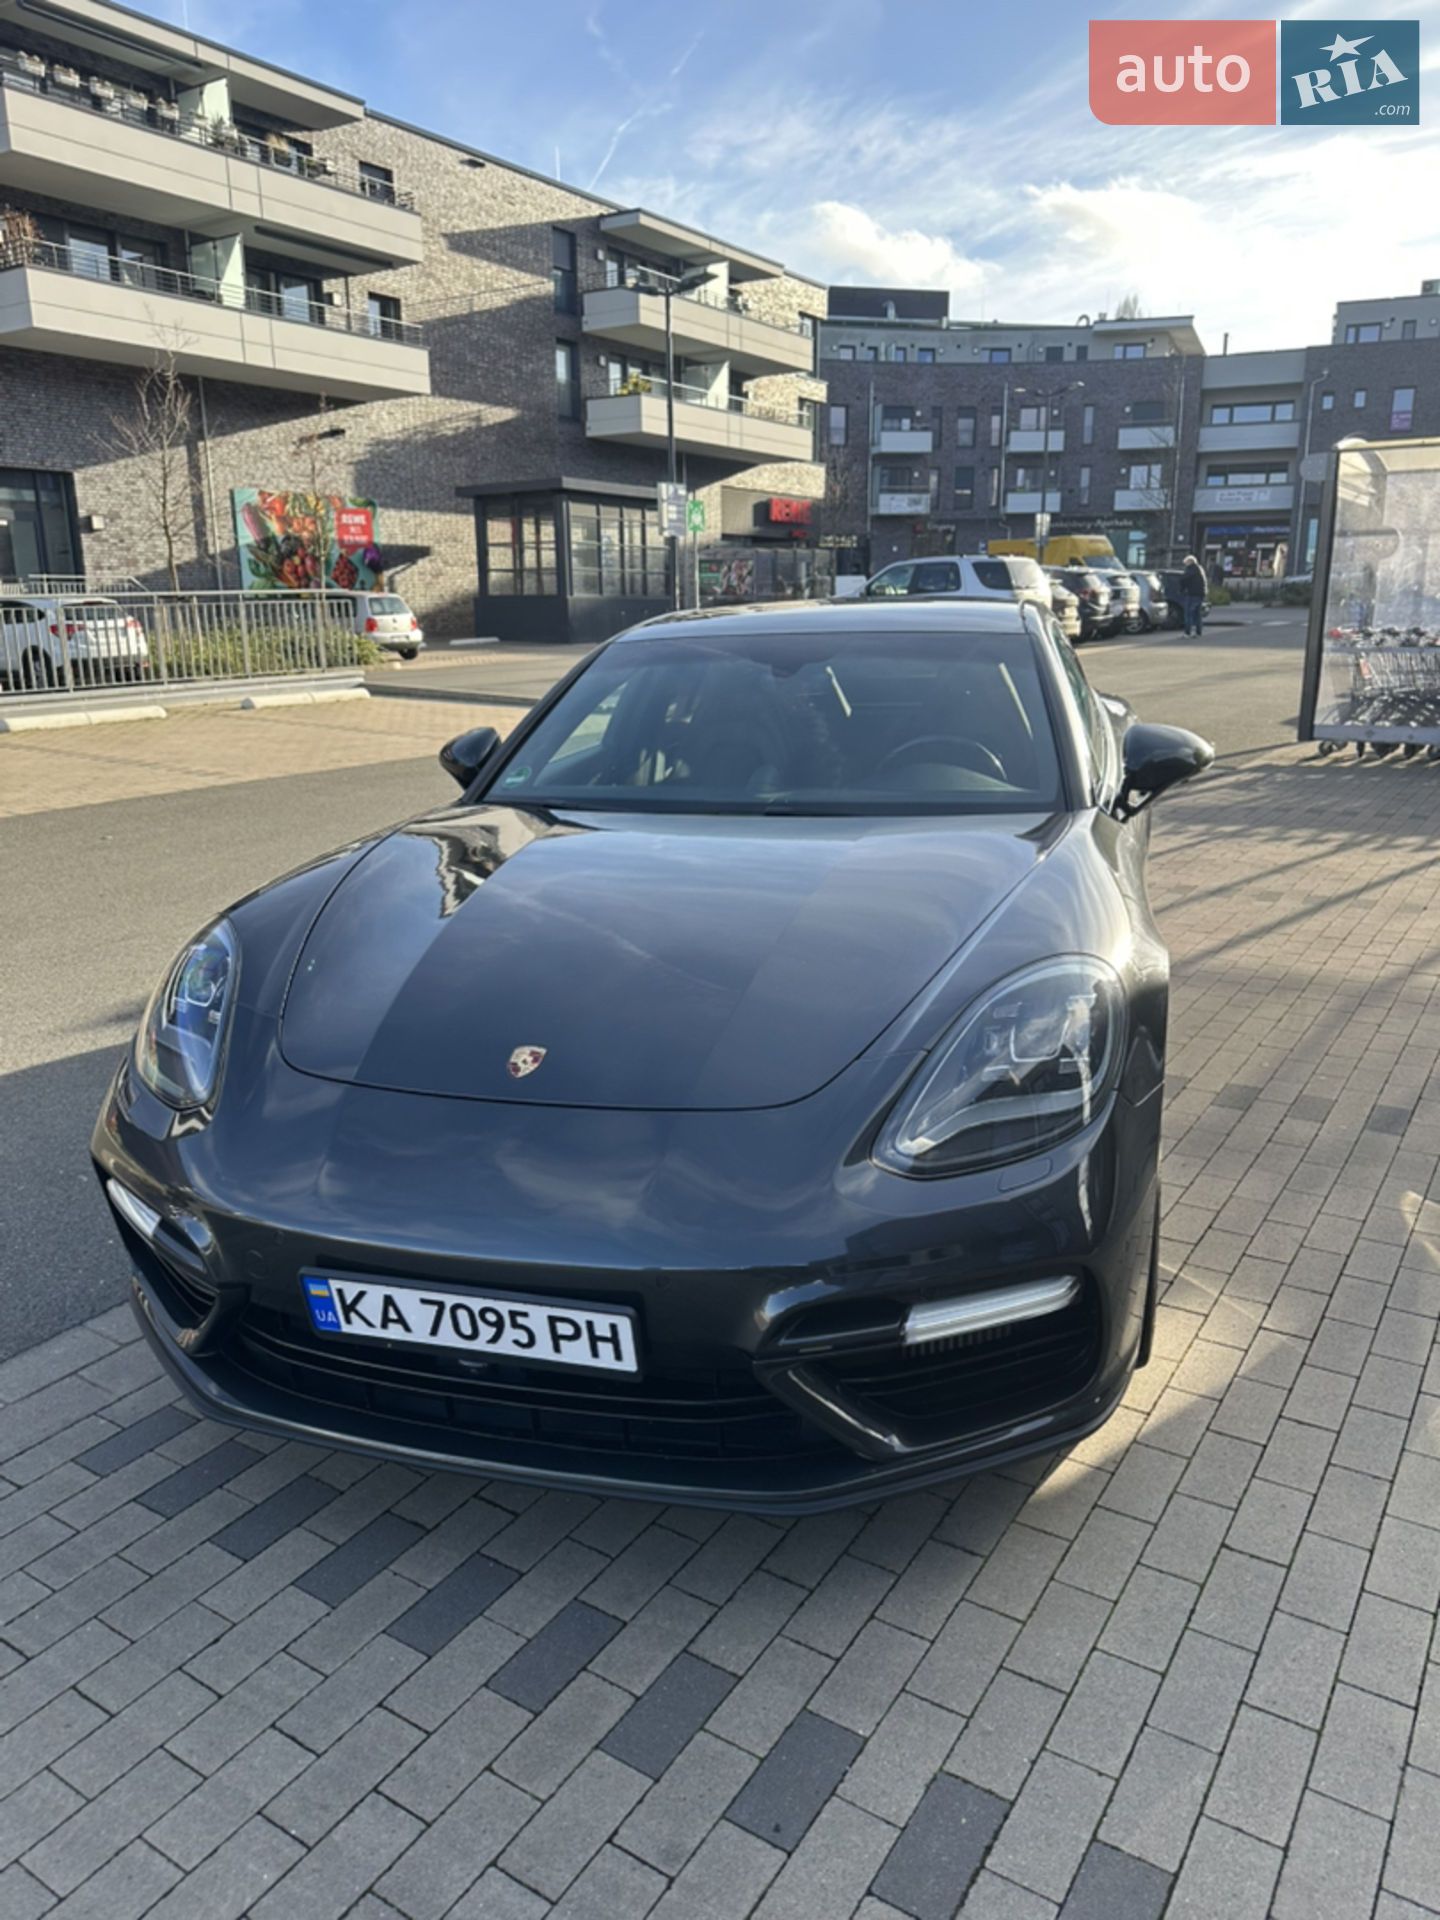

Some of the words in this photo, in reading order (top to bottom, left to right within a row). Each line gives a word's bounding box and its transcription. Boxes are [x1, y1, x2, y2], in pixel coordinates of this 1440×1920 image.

[768, 497, 812, 524] REWE
[315, 1308, 338, 1325] UA
[335, 1287, 413, 1334] KA
[419, 1297, 536, 1350] 7095
[547, 1314, 624, 1363] PH
